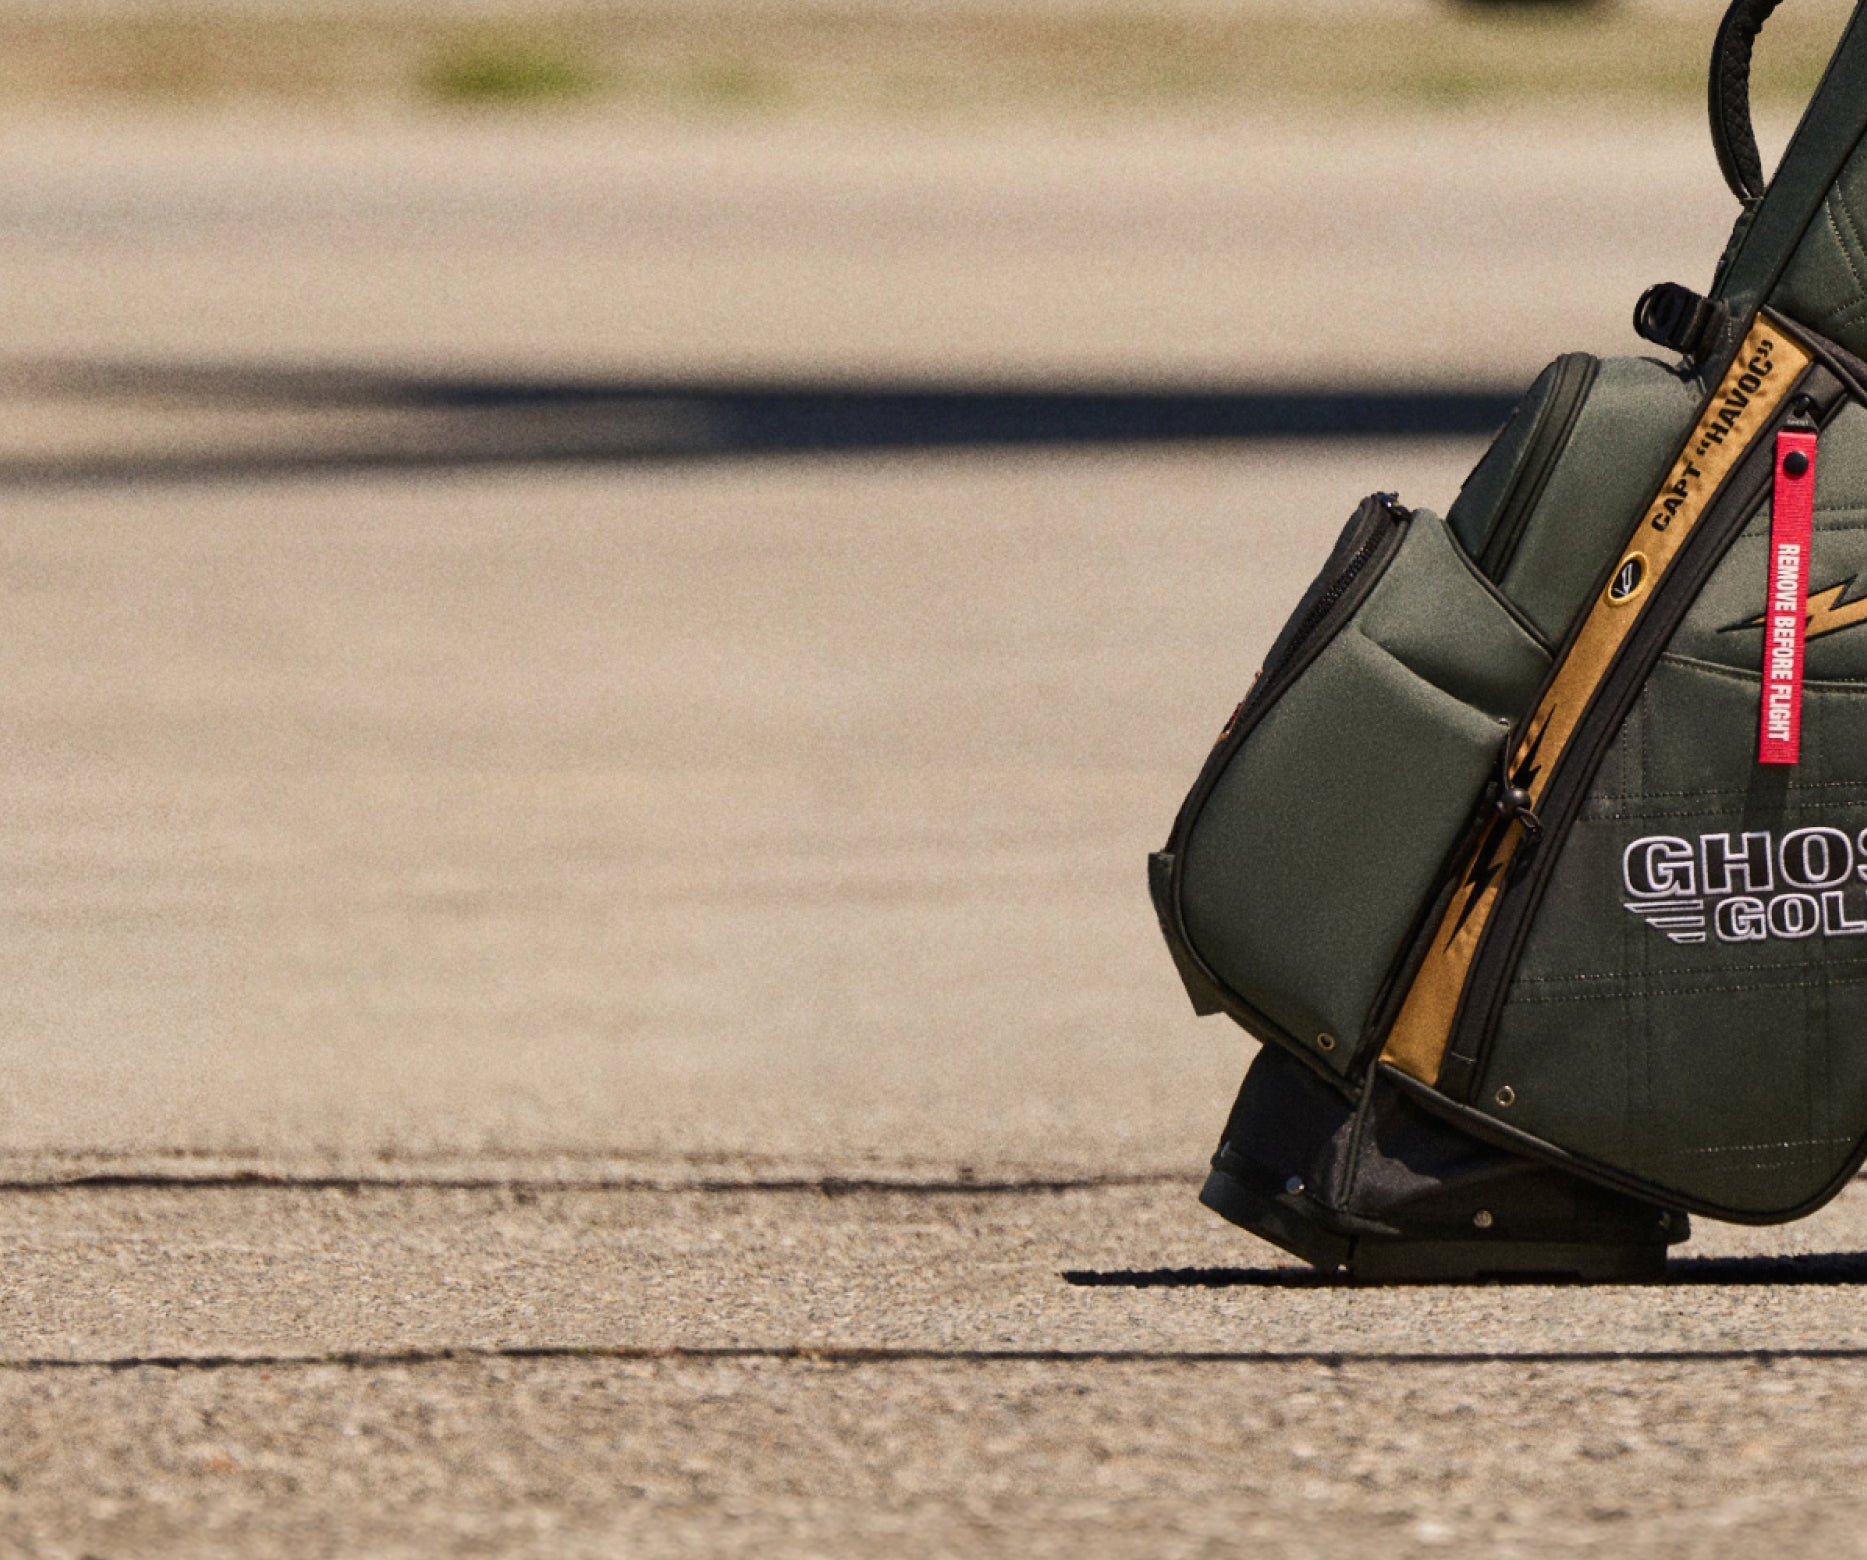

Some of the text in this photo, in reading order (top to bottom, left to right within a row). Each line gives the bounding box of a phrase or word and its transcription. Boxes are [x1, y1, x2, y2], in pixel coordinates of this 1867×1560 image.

[1651, 461, 1701, 532] CAPT
[1767, 544, 1801, 742] REMOVE BEFORE FLIGHT
